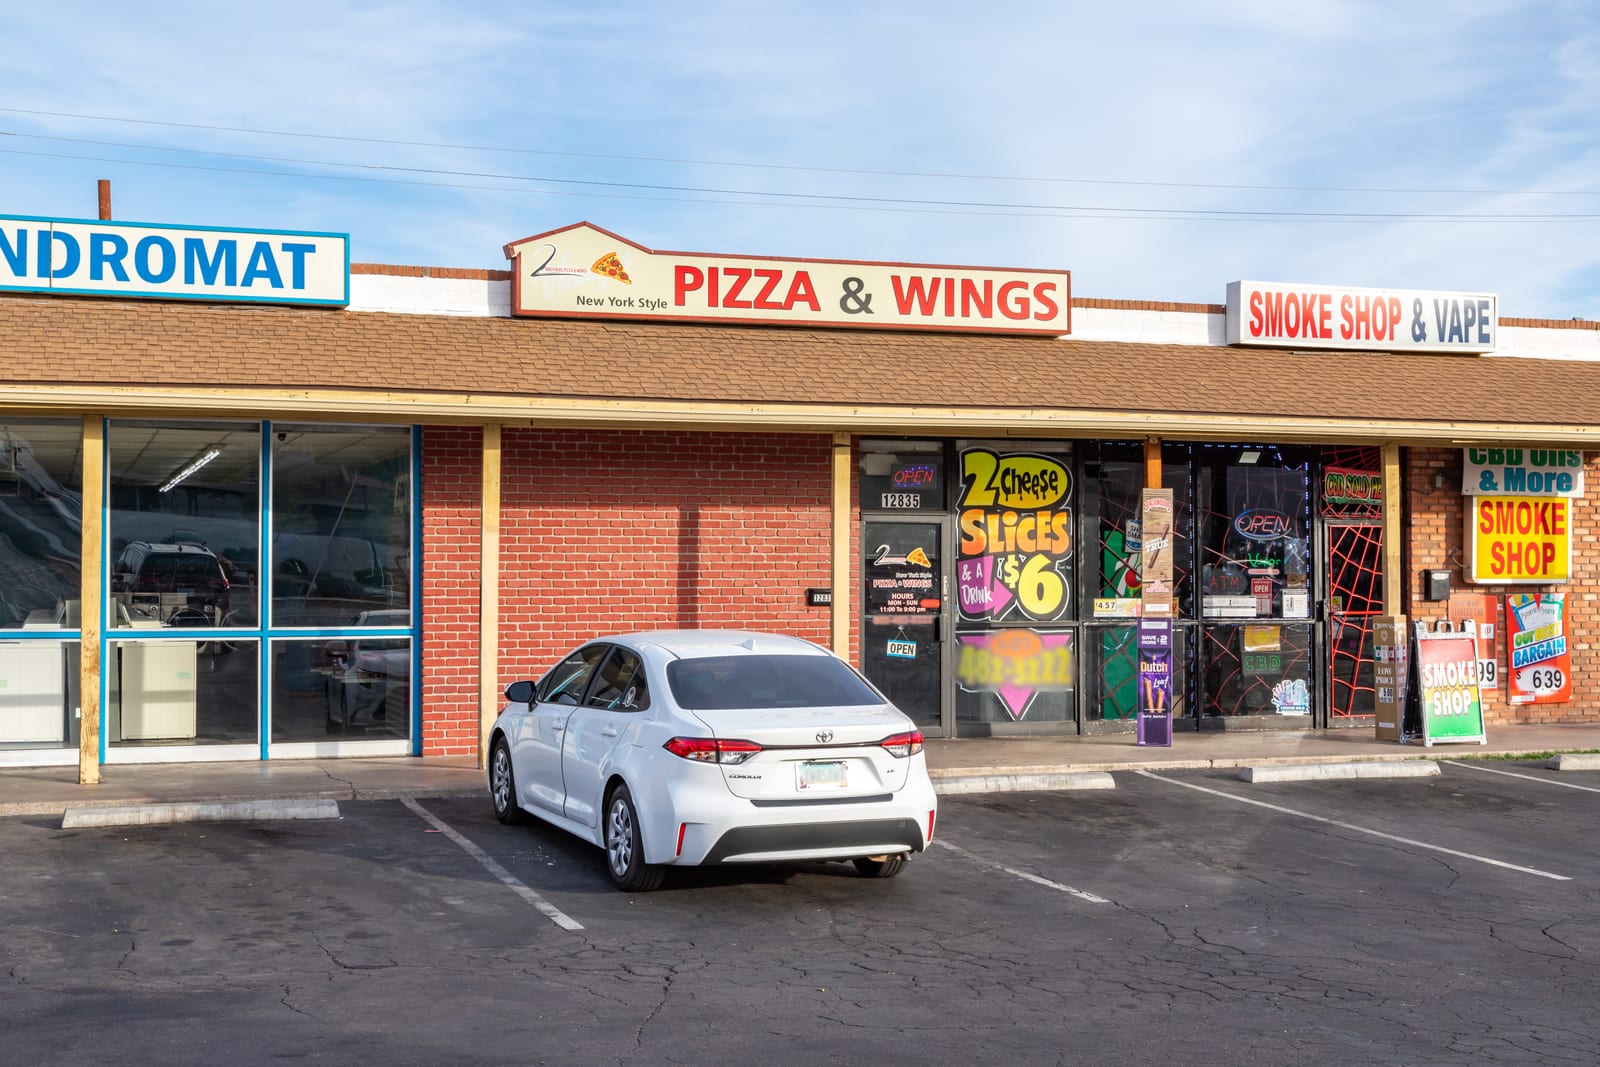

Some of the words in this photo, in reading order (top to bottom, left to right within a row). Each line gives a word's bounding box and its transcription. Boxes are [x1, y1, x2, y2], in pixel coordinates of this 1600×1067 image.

[531, 244, 585, 278] 2
[674, 265, 821, 311] PIZZA
[839, 277, 874, 315] &
[890, 275, 1059, 322] WINGS
[576, 295, 604, 306] New
[608, 296, 635, 308] York
[638, 298, 668, 311] Style
[1249, 290, 1332, 339] SMOKE
[1340, 295, 1401, 341] SHOP
[1411, 298, 1427, 343] &
[1433, 299, 1491, 344] VAPE
[1469, 448, 1523, 466] CBD
[893, 470, 935, 483] OPEN
[962, 451, 998, 507] 2
[1000, 467, 1059, 502] Cheese
[1479, 470, 1498, 491] &
[1503, 467, 1573, 493] More
[1326, 474, 1345, 497] CBD
[1345, 474, 1369, 498] SOLD
[882, 494, 919, 508] 12835
[1237, 515, 1290, 532] OPEN
[1480, 501, 1565, 535] SMOKE
[1146, 540, 1169, 552] TRUE
[1490, 541, 1556, 575] SHOP
[976, 563, 983, 578] A
[903, 579, 932, 588] WINGS
[1210, 576, 1239, 590] ATM
[1254, 585, 1269, 593] OPEN
[1535, 622, 1560, 641] BEST
[890, 643, 914, 655] OPEN
[1513, 637, 1565, 667] BARGAIN
[1141, 661, 1168, 673] Dutch
[1245, 655, 1280, 672] CBD
[1378, 667, 1392, 675] LOW
[1376, 676, 1393, 684] PRICE
[1424, 660, 1476, 689] SMOKE
[1516, 670, 1521, 680] $
[1433, 688, 1473, 717] SHOP
